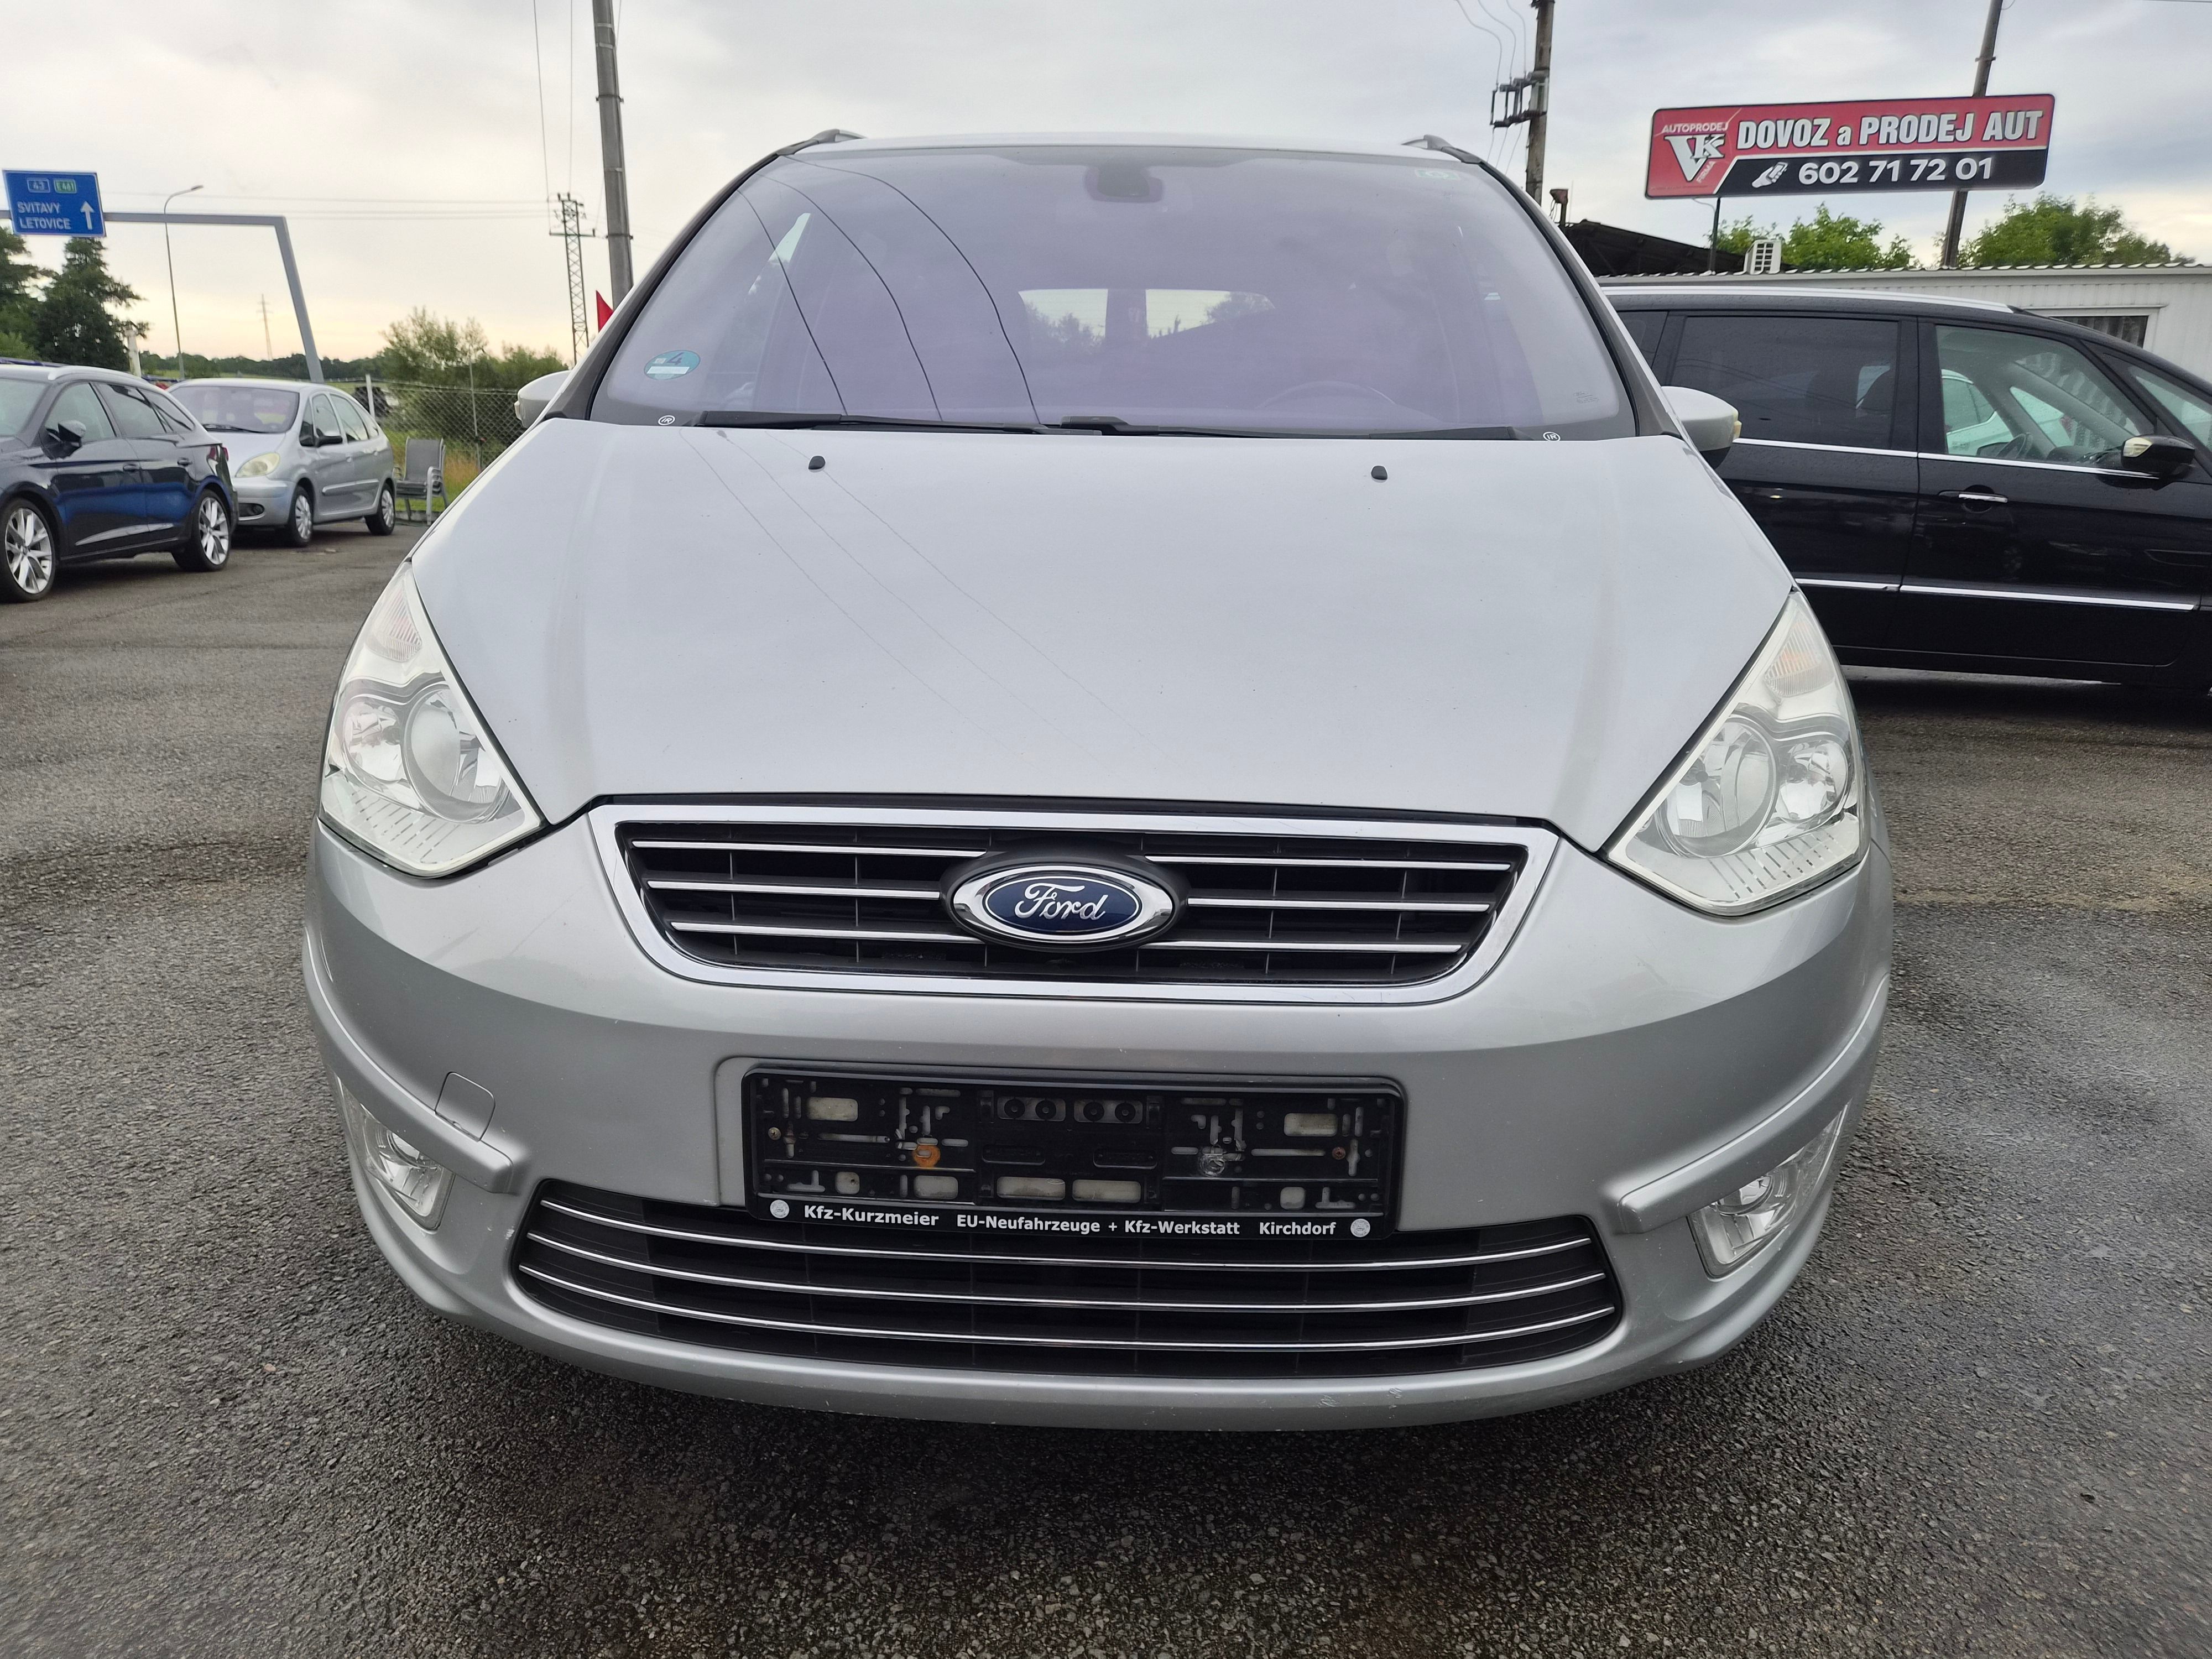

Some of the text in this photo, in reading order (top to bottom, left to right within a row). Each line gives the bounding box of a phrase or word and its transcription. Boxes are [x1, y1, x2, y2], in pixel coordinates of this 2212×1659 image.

[1662, 122, 1729, 133] AUTOPRODEJ
[1737, 111, 2043, 149] DOVOZ a PRODEJ AUT
[1696, 161, 1716, 184] FIRMA
[1798, 157, 1991, 185] 602 71 72 01
[17, 201, 60, 213] SVITAVY
[19, 217, 71, 229] LETOVICE
[667, 352, 684, 365] 4
[1014, 882, 1108, 921] Ford
[804, 1204, 940, 1226] Kfz-Kurzmeier
[957, 1214, 1101, 1235] EU-Neufahrzeuge
[1124, 1219, 1241, 1235] Kfz-Werkstatt
[1259, 1221, 1337, 1235] Kirchdorf
